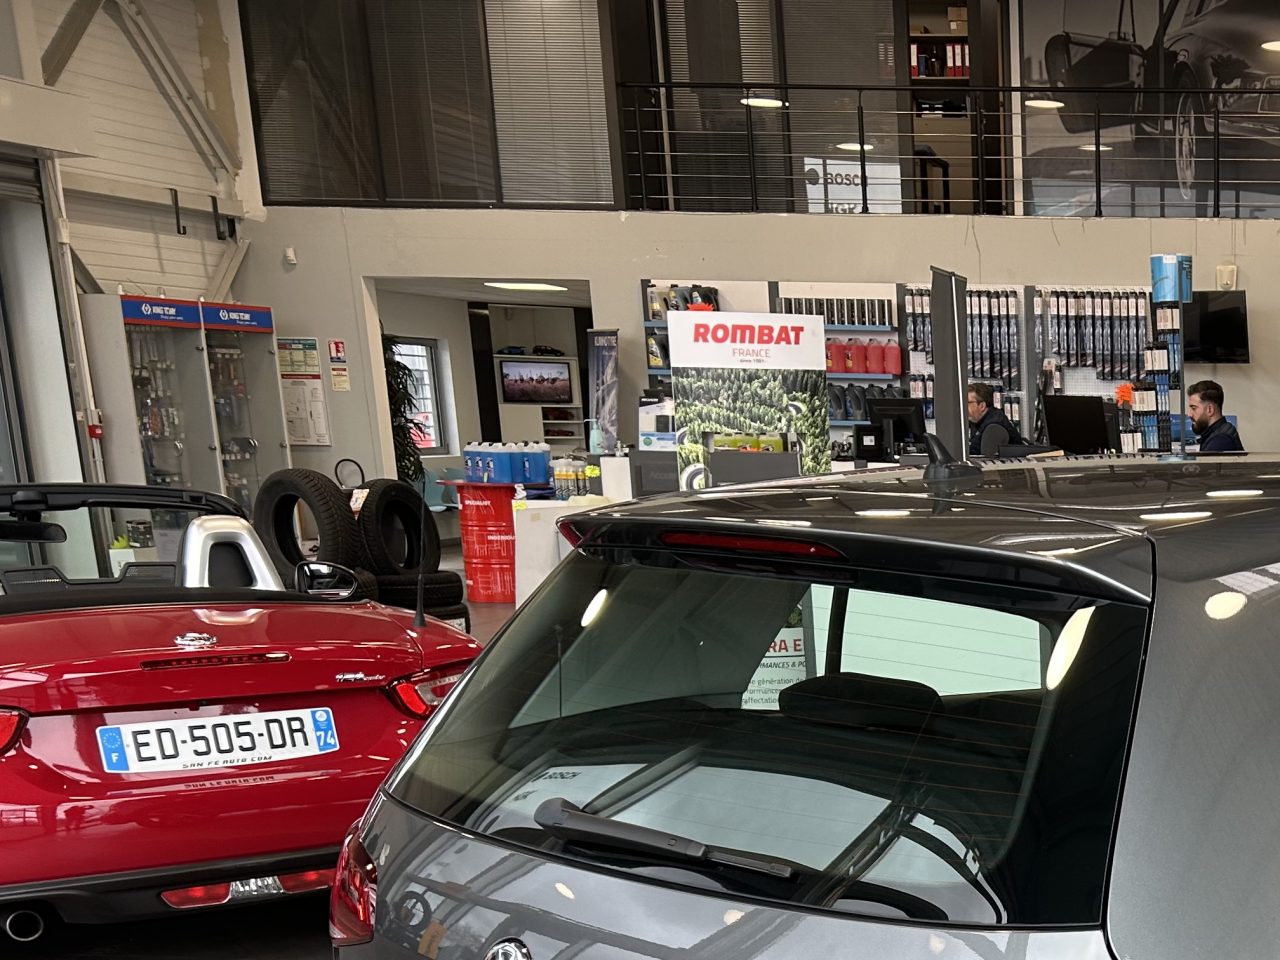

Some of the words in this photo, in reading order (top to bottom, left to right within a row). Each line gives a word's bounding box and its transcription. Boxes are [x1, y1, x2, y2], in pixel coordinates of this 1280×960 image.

[826, 172, 867, 187] BOSC
[693, 323, 805, 345] ROMBAT
[732, 348, 771, 358] FRANCE
[131, 716, 309, 763] ED-505-DR
[316, 729, 336, 748] 74
[111, 752, 119, 764] F
[182, 761, 204, 769] SAN
